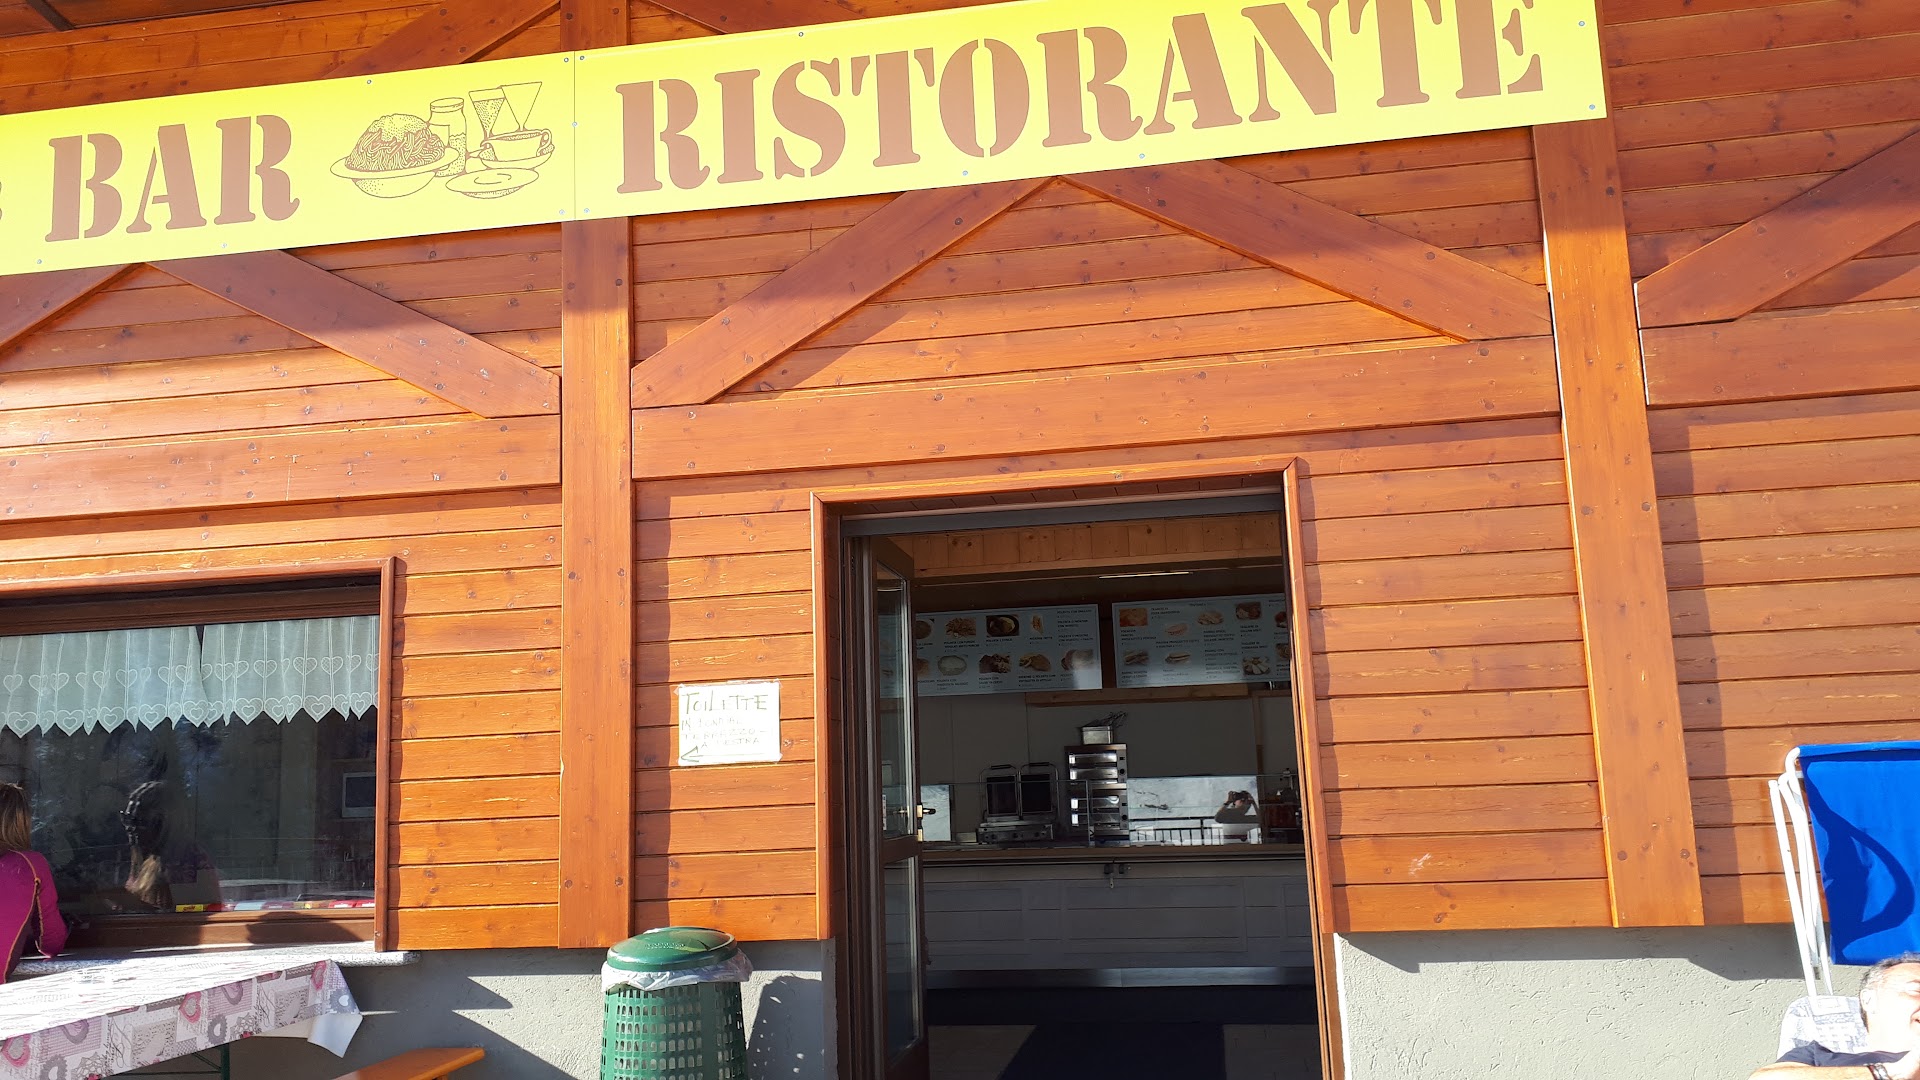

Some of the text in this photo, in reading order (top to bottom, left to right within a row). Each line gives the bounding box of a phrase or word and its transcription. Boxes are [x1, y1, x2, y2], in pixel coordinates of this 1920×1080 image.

[44, 0, 1544, 242] BAR RISTORANTE
[681, 690, 769, 715] TOILETTE
